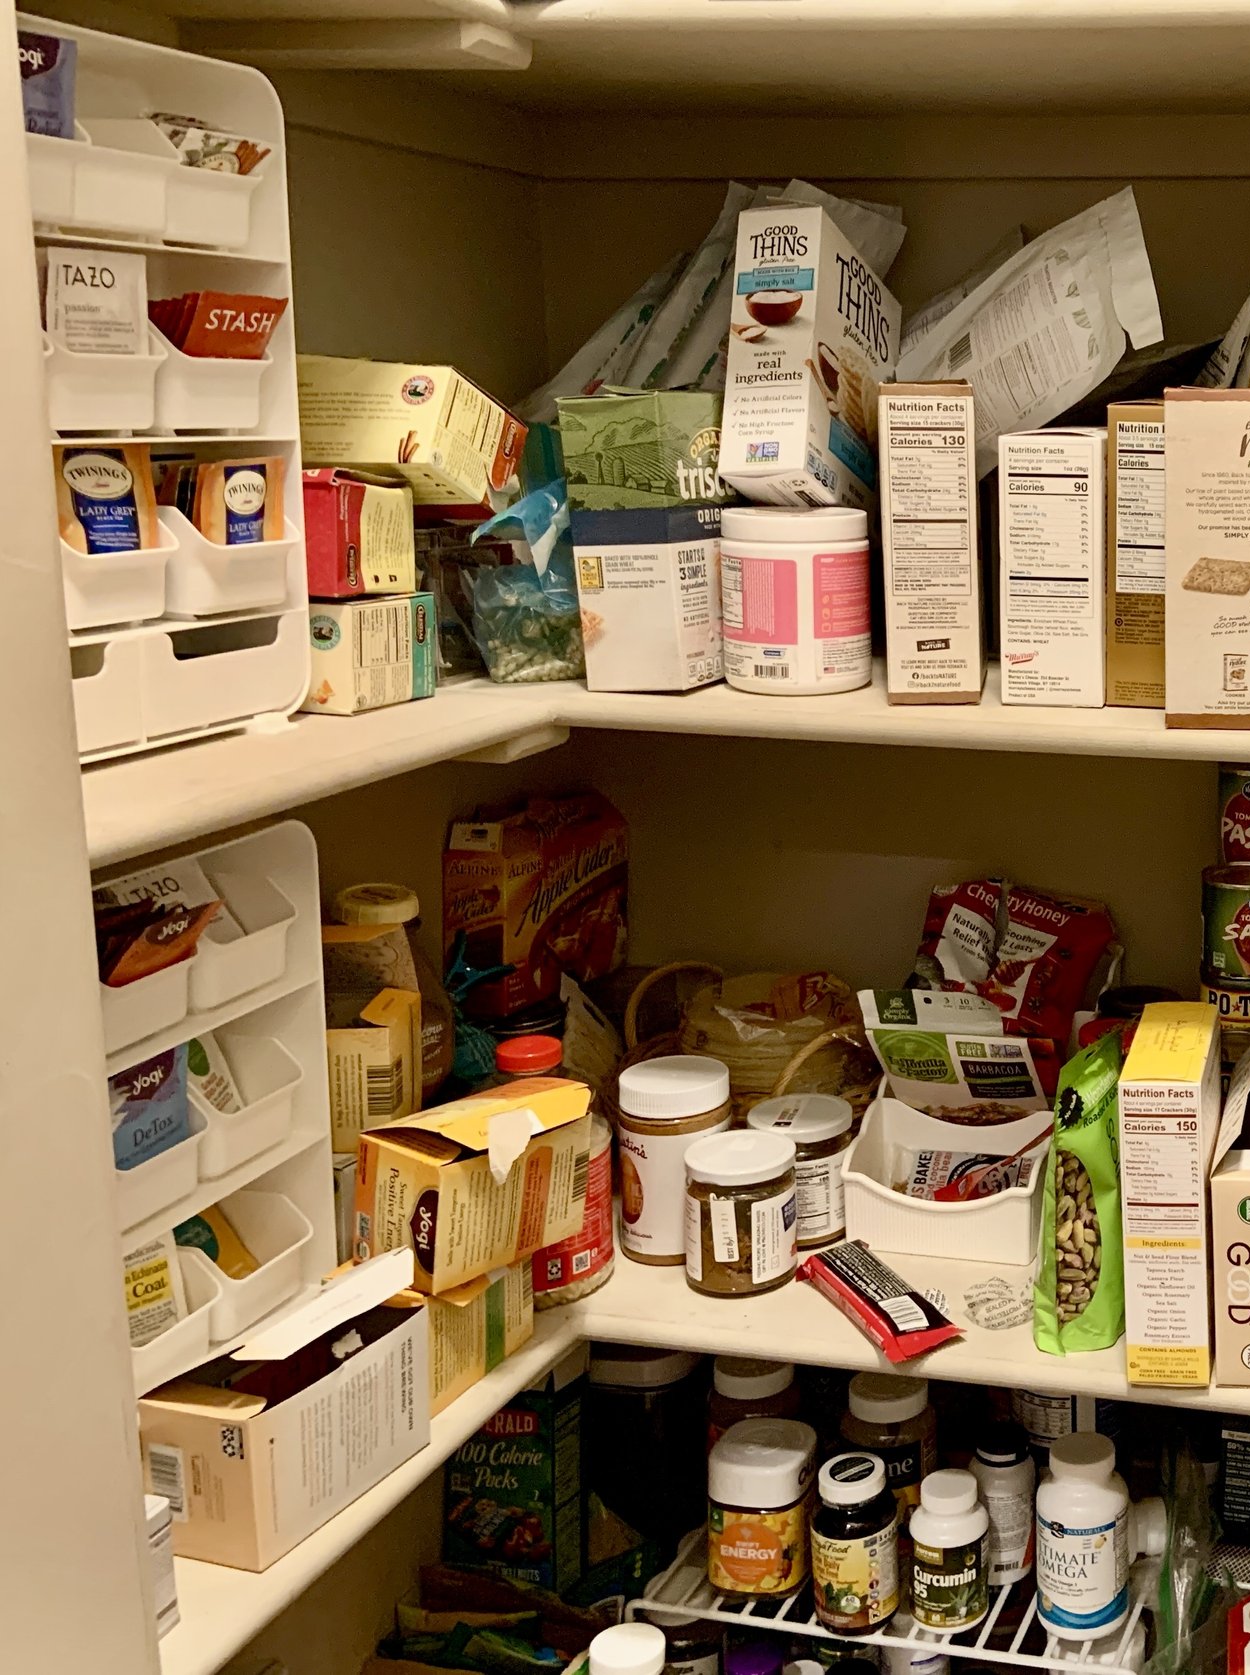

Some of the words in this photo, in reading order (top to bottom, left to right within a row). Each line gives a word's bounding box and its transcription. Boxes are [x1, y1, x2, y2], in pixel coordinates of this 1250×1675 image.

[764, 225, 798, 238] GOOD
[750, 233, 808, 259] THINS
[62, 264, 115, 289] TAZO
[754, 278, 780, 289] simply
[781, 277, 795, 287] salt
[850, 255, 882, 306] GOOD
[836, 252, 890, 363] THINS
[205, 308, 276, 334] STASH
[753, 350, 771, 358] made
[757, 357, 782, 370] real
[735, 370, 803, 385] ingredients
[751, 394, 781, 403] Artificial
[781, 393, 803, 401] Colors
[750, 407, 780, 415] Artificial
[889, 402, 934, 412] Nutrition
[936, 402, 965, 412] Facts
[1118, 423, 1160, 434] Nutrition
[890, 437, 933, 446] Calories
[941, 435, 966, 446] 130
[1008, 446, 1042, 454] Nutrition
[1043, 446, 1065, 455] Facts
[1008, 465, 1031, 473] Serving
[1118, 458, 1150, 468] Calories
[67, 464, 129, 482] TWININGS
[227, 482, 265, 499] TWININGS
[1009, 482, 1046, 492] Calories
[1073, 481, 1089, 493] 90
[79, 506, 109, 517] LADY
[109, 506, 137, 517] GREY
[229, 522, 248, 533] LADY
[1224, 532, 1250, 540] SIMPLY
[678, 549, 701, 565] STARTS
[679, 568, 687, 580] 3
[686, 564, 708, 580] SIMPLE
[680, 581, 709, 593] ingredients
[449, 860, 500, 875] ALPINE
[129, 876, 181, 901] TAZO
[1021, 899, 1071, 927] Honey
[157, 915, 191, 941] yogi
[952, 912, 992, 945] Naturally
[952, 926, 981, 949] Relief
[1008, 940, 1034, 954] Lasts
[960, 1047, 986, 1057] FREE
[905, 1066, 949, 1078] Factory
[968, 1063, 1023, 1075] BARBACOA
[132, 1066, 164, 1096] yogi
[1123, 1088, 1166, 1099] Nutrition
[1168, 1088, 1195, 1099] Facts
[1123, 1106, 1141, 1114] Serving
[132, 1114, 174, 1148] DeTox
[1124, 1122, 1167, 1132] Calories
[1176, 1120, 1198, 1132] 150
[387, 1167, 400, 1217] Positive
[399, 1181, 409, 1211] Sweet
[418, 1206, 433, 1251] yogi
[1141, 1239, 1186, 1249] Ingredients
[132, 1276, 168, 1299] Coat
[1136, 1283, 1158, 1291] Organic
[1142, 1292, 1164, 1300] Organic
[1146, 1308, 1168, 1316] Organic
[1146, 1316, 1168, 1324] Organic
[1146, 1324, 1167, 1332] Organic
[1168, 1325, 1188, 1333] Pepper
[488, 1441, 543, 1467] Calorie
[475, 1466, 519, 1490] Packs
[719, 1544, 778, 1561] ENERGY
[913, 1564, 977, 1587] Curcumin
[912, 1580, 928, 1599] 95
